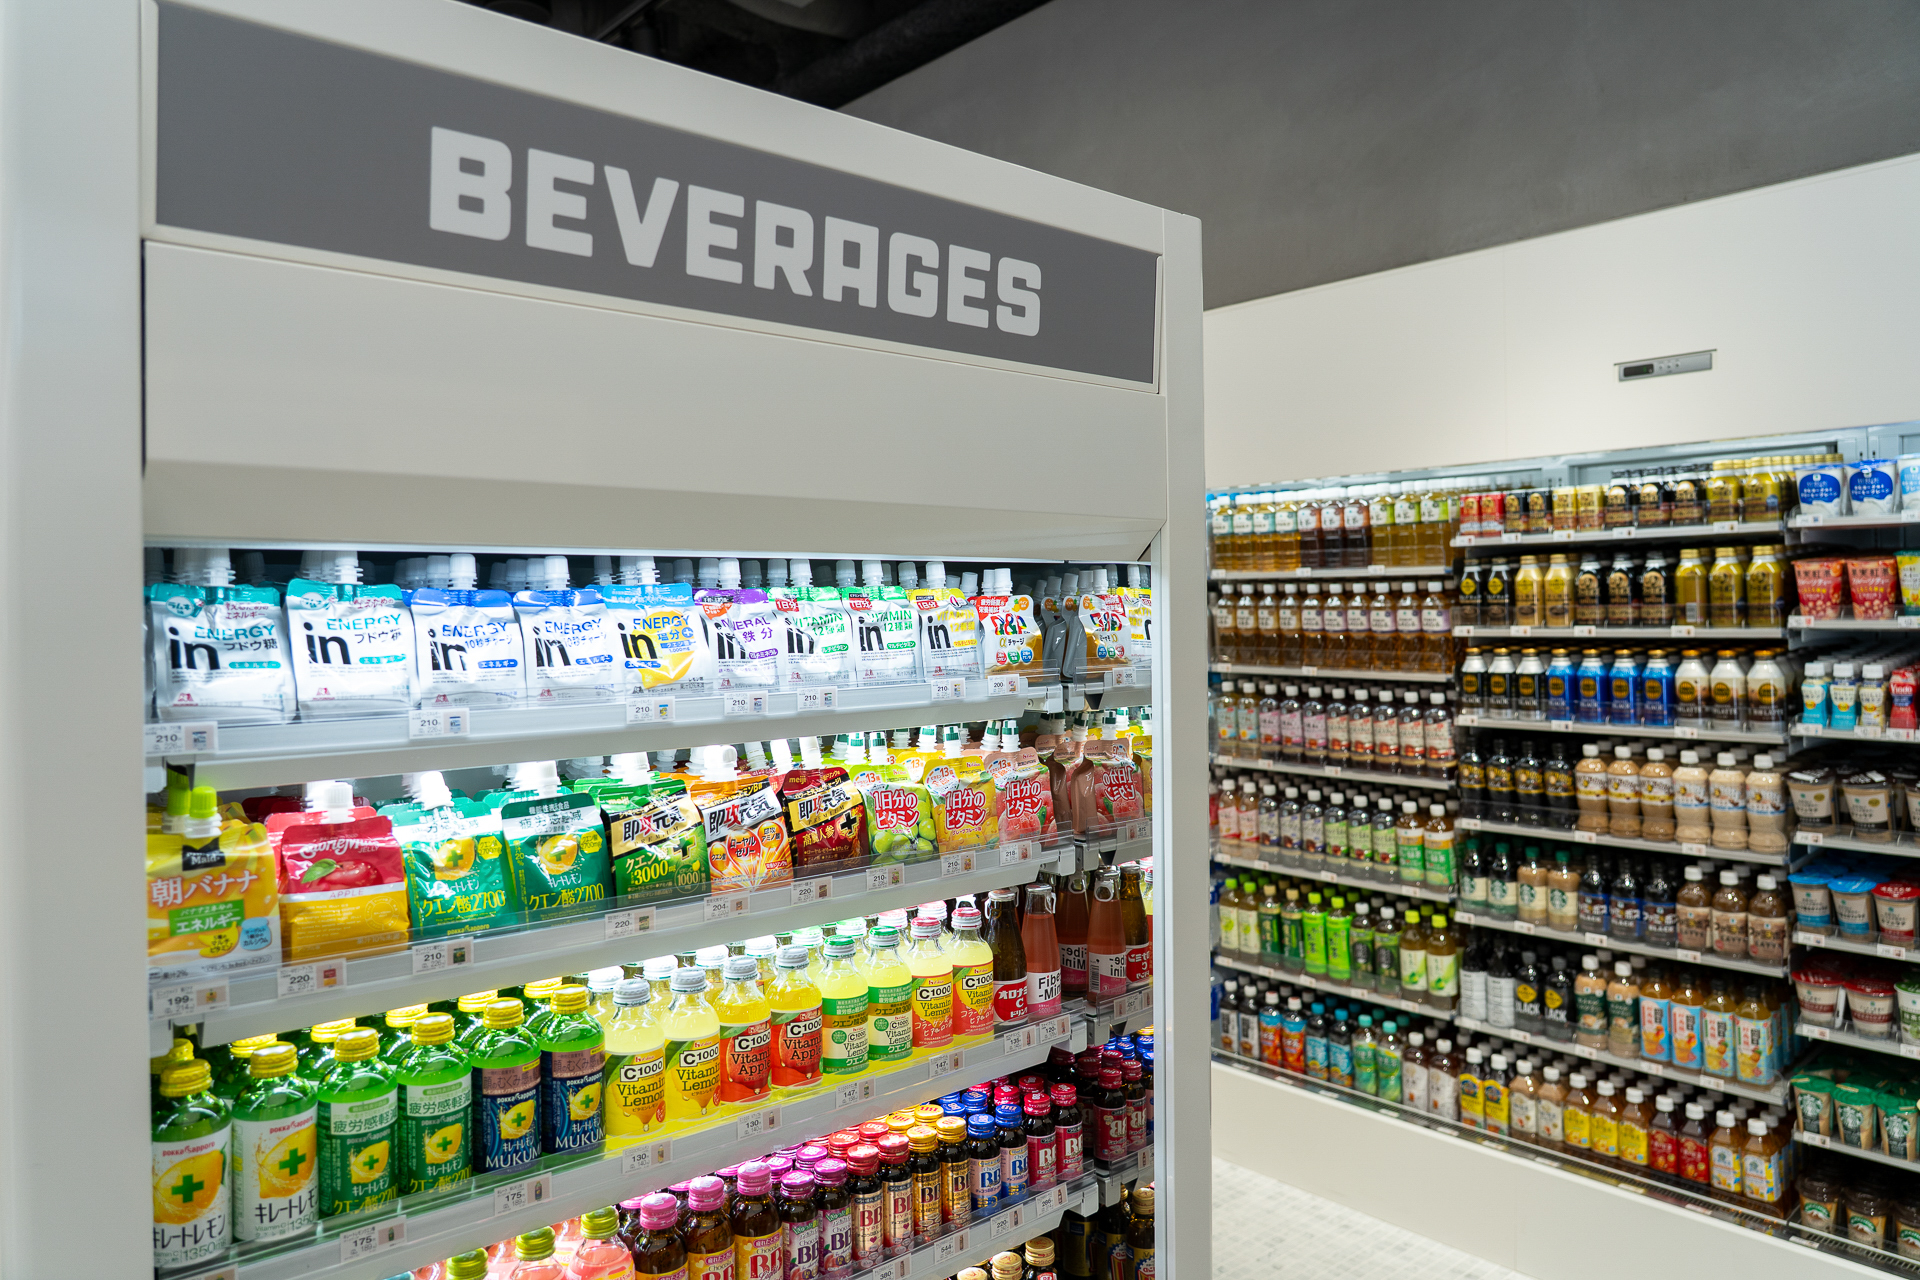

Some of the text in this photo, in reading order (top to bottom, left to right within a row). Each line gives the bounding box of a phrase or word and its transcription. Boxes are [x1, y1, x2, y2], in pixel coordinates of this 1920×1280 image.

[429, 126, 1042, 337] BEVERAGES
[326, 613, 402, 631] ENERGY
[633, 615, 690, 630] ENERGY
[792, 612, 844, 628] VITAMIN
[866, 609, 912, 623] VITAMIN
[195, 624, 275, 640] ENERGY
[442, 621, 507, 638] ENERGY
[545, 617, 602, 635] ENERGY
[858, 616, 884, 651] in
[884, 620, 913, 632] 12種類
[927, 615, 951, 650] in
[168, 626, 220, 670] in
[224, 638, 278, 651] ブドウ糖
[303, 621, 352, 665] in
[532, 625, 571, 668] in
[617, 622, 658, 659] in
[427, 628, 467, 671] in
[804, 694, 817, 702] 210
[420, 719, 438, 727] 210
[156, 734, 177, 742] 210
[789, 776, 807, 784] meiji
[1006, 780, 1041, 801] 1日分の
[873, 789, 918, 811] 1日分の
[945, 788, 986, 811] 1日分の
[1006, 798, 1042, 819] ビタミン
[875, 809, 920, 830] ビタミン
[946, 808, 986, 830] ビタミン
[730, 836, 756, 849] ローヤル
[735, 847, 755, 858] ゼリー
[677, 871, 699, 886] 1000
[151, 870, 258, 908] 朝バナナ
[329, 888, 364, 900] APPLE
[529, 883, 604, 910] クエン酸2700
[799, 888, 811, 896] 220
[422, 889, 506, 918] クエン酸2700
[712, 903, 726, 912] 204
[176, 912, 242, 933] エネルギー
[615, 920, 630, 929] 220
[424, 952, 442, 962] 210
[290, 974, 310, 985] 220
[965, 973, 993, 989] C1000
[167, 994, 190, 1006] 199
[919, 985, 951, 1000] C1000
[920, 1000, 951, 1012] Vitamin
[1015, 998, 1024, 1008] C
[924, 1007, 951, 1017] Lemon
[738, 1031, 771, 1050] C1000
[683, 1046, 719, 1066] C1000
[623, 1060, 664, 1081] C1000
[738, 1059, 771, 1077] Apple
[617, 1076, 665, 1096] Vitamin
[844, 1090, 855, 1098] 147
[623, 1089, 665, 1107] Lemon
[270, 1116, 313, 1134] pokka sapporo
[746, 1119, 759, 1129] 130
[162, 1141, 215, 1157] pokka sapporo
[632, 1153, 647, 1162] 130
[427, 1159, 463, 1176] キレートレモン
[352, 1177, 389, 1197] キレートレモン
[505, 1191, 522, 1202] 175
[153, 1214, 226, 1250] キレートレモン
[353, 1235, 373, 1247] 175
[750, 1247, 782, 1279] BB
